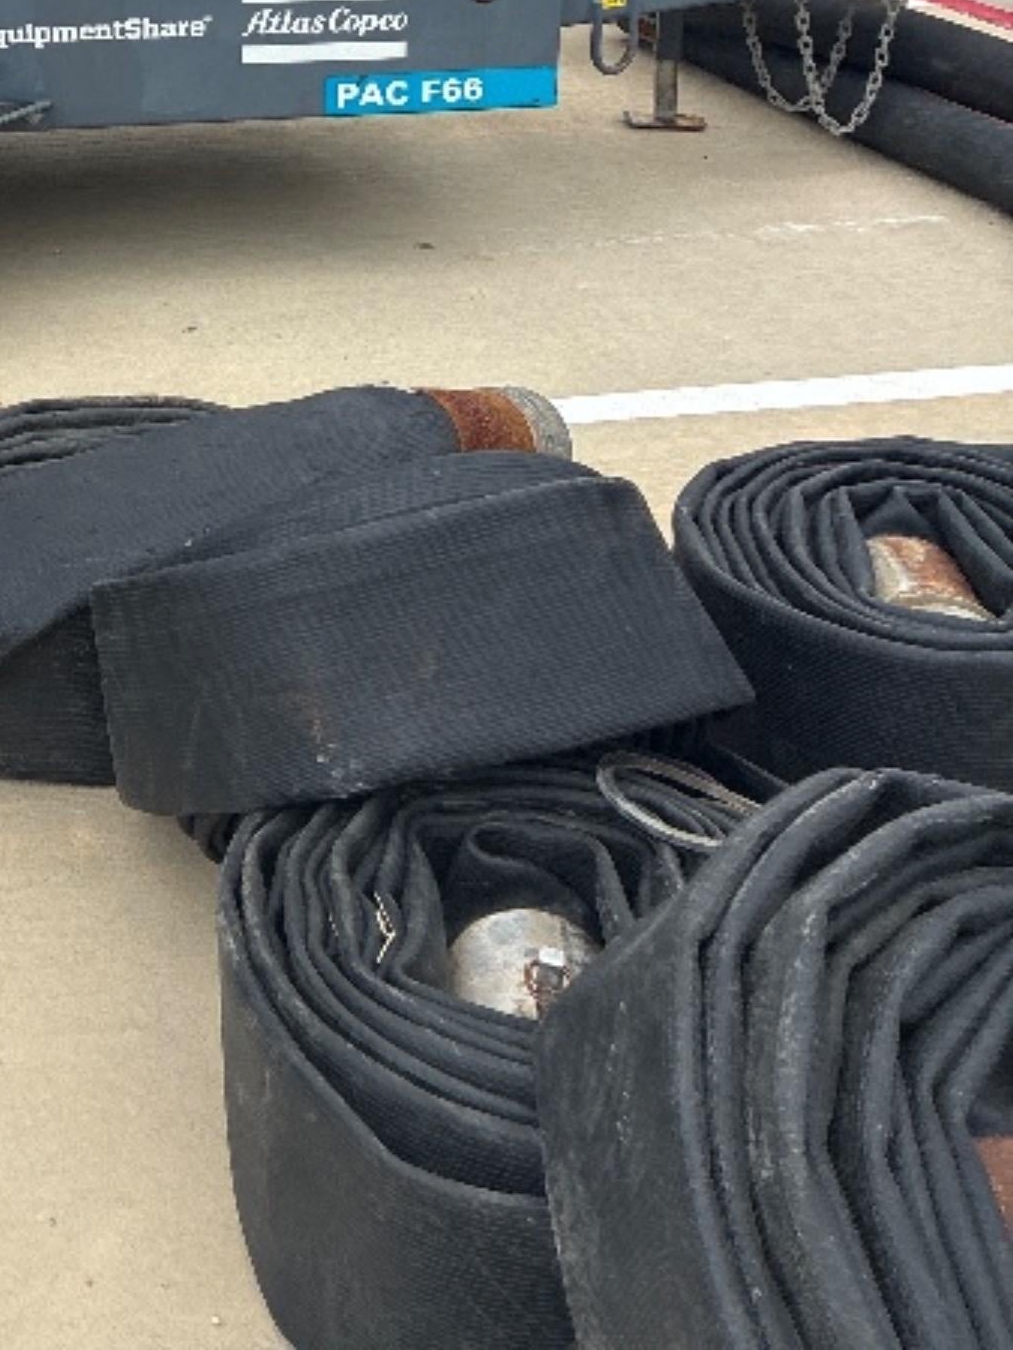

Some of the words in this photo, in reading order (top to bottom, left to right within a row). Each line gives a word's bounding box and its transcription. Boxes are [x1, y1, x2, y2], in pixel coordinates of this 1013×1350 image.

[241, 8, 327, 37] Atlas
[328, 5, 408, 38] Copco
[337, 81, 409, 109] PAC
[421, 77, 484, 103] F66
